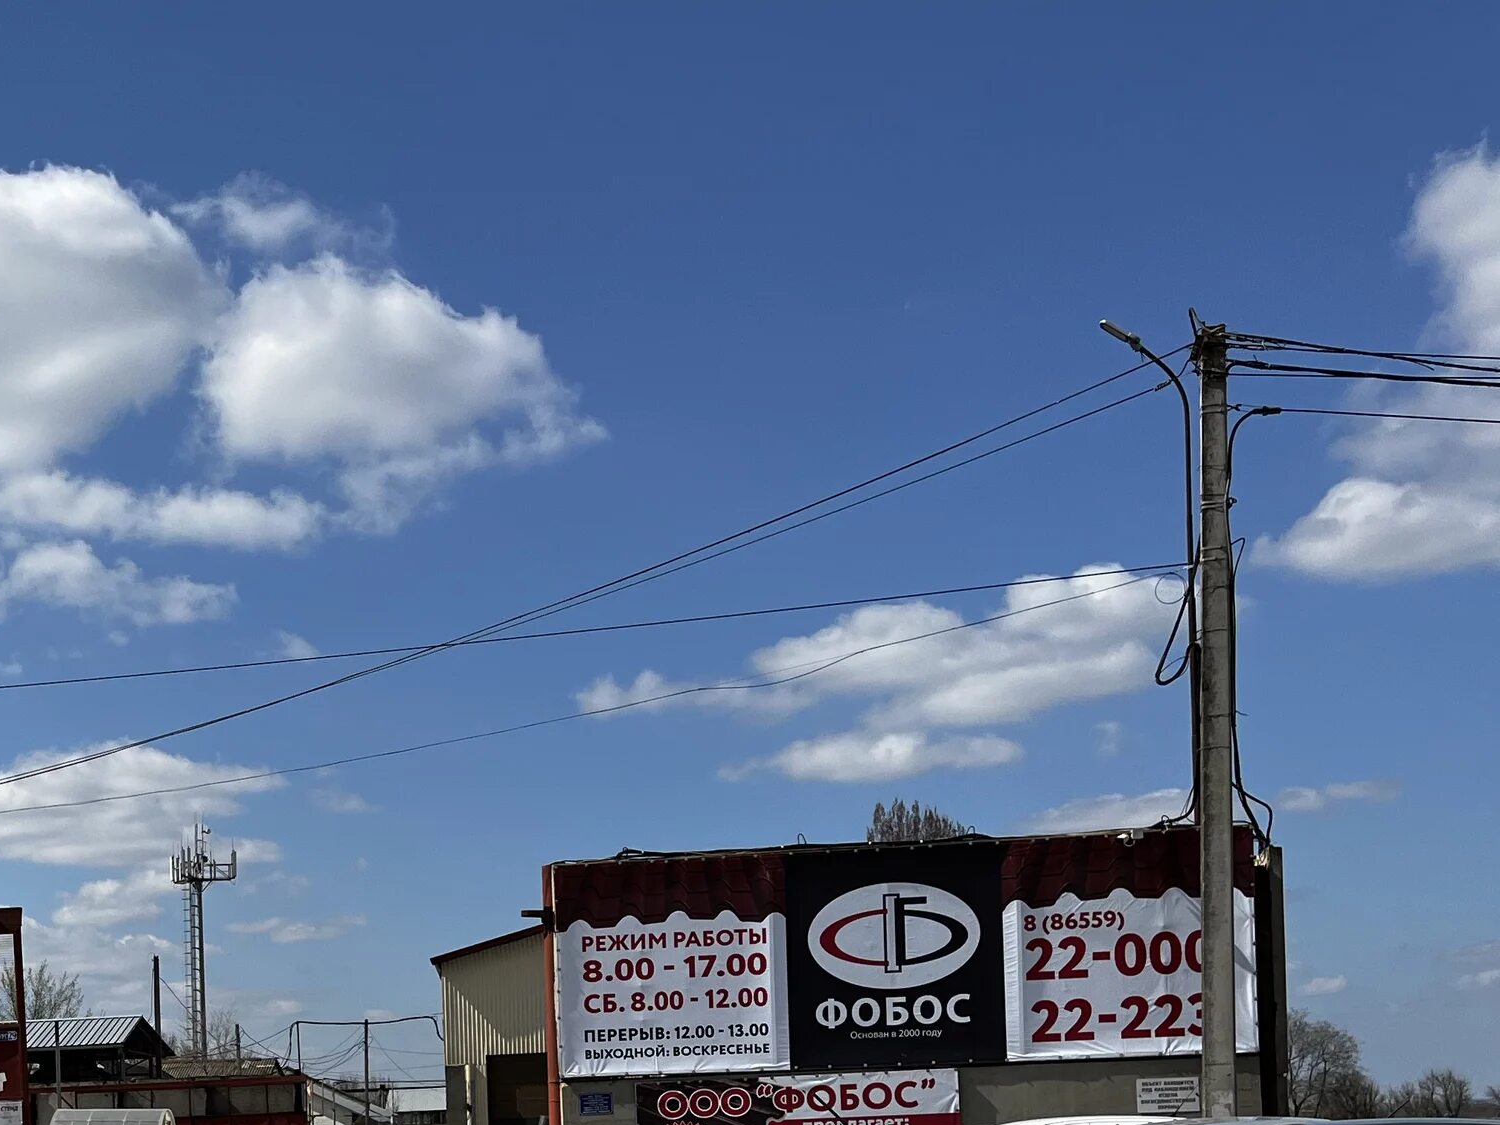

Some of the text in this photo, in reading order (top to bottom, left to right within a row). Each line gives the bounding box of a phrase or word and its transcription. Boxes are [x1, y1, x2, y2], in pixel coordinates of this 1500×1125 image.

[1023, 910, 1125, 935] 8 (86559)
[582, 928, 767, 952] РЕЖИМ РАБОТЫ
[582, 957, 654, 982] 8.00
[684, 952, 767, 978] 17.00
[584, 993, 625, 1013] СБ.
[630, 991, 684, 1011] 8.00
[705, 987, 768, 1008] 12.00
[815, 993, 971, 1029] ФОБОС
[584, 1027, 670, 1043] ПЕРЕРЫВ:
[674, 1025, 714, 1039] 12.00
[728, 1023, 769, 1037] 13.00
[850, 1030, 889, 1039] Основан
[899, 1029, 920, 1037] 2000
[922, 1030, 942, 1038] году
[585, 1043, 770, 1060] ВЫХОДНОЙ: ВОСКРЕСЕНЬЕ
[658, 1087, 751, 1119] ООО
